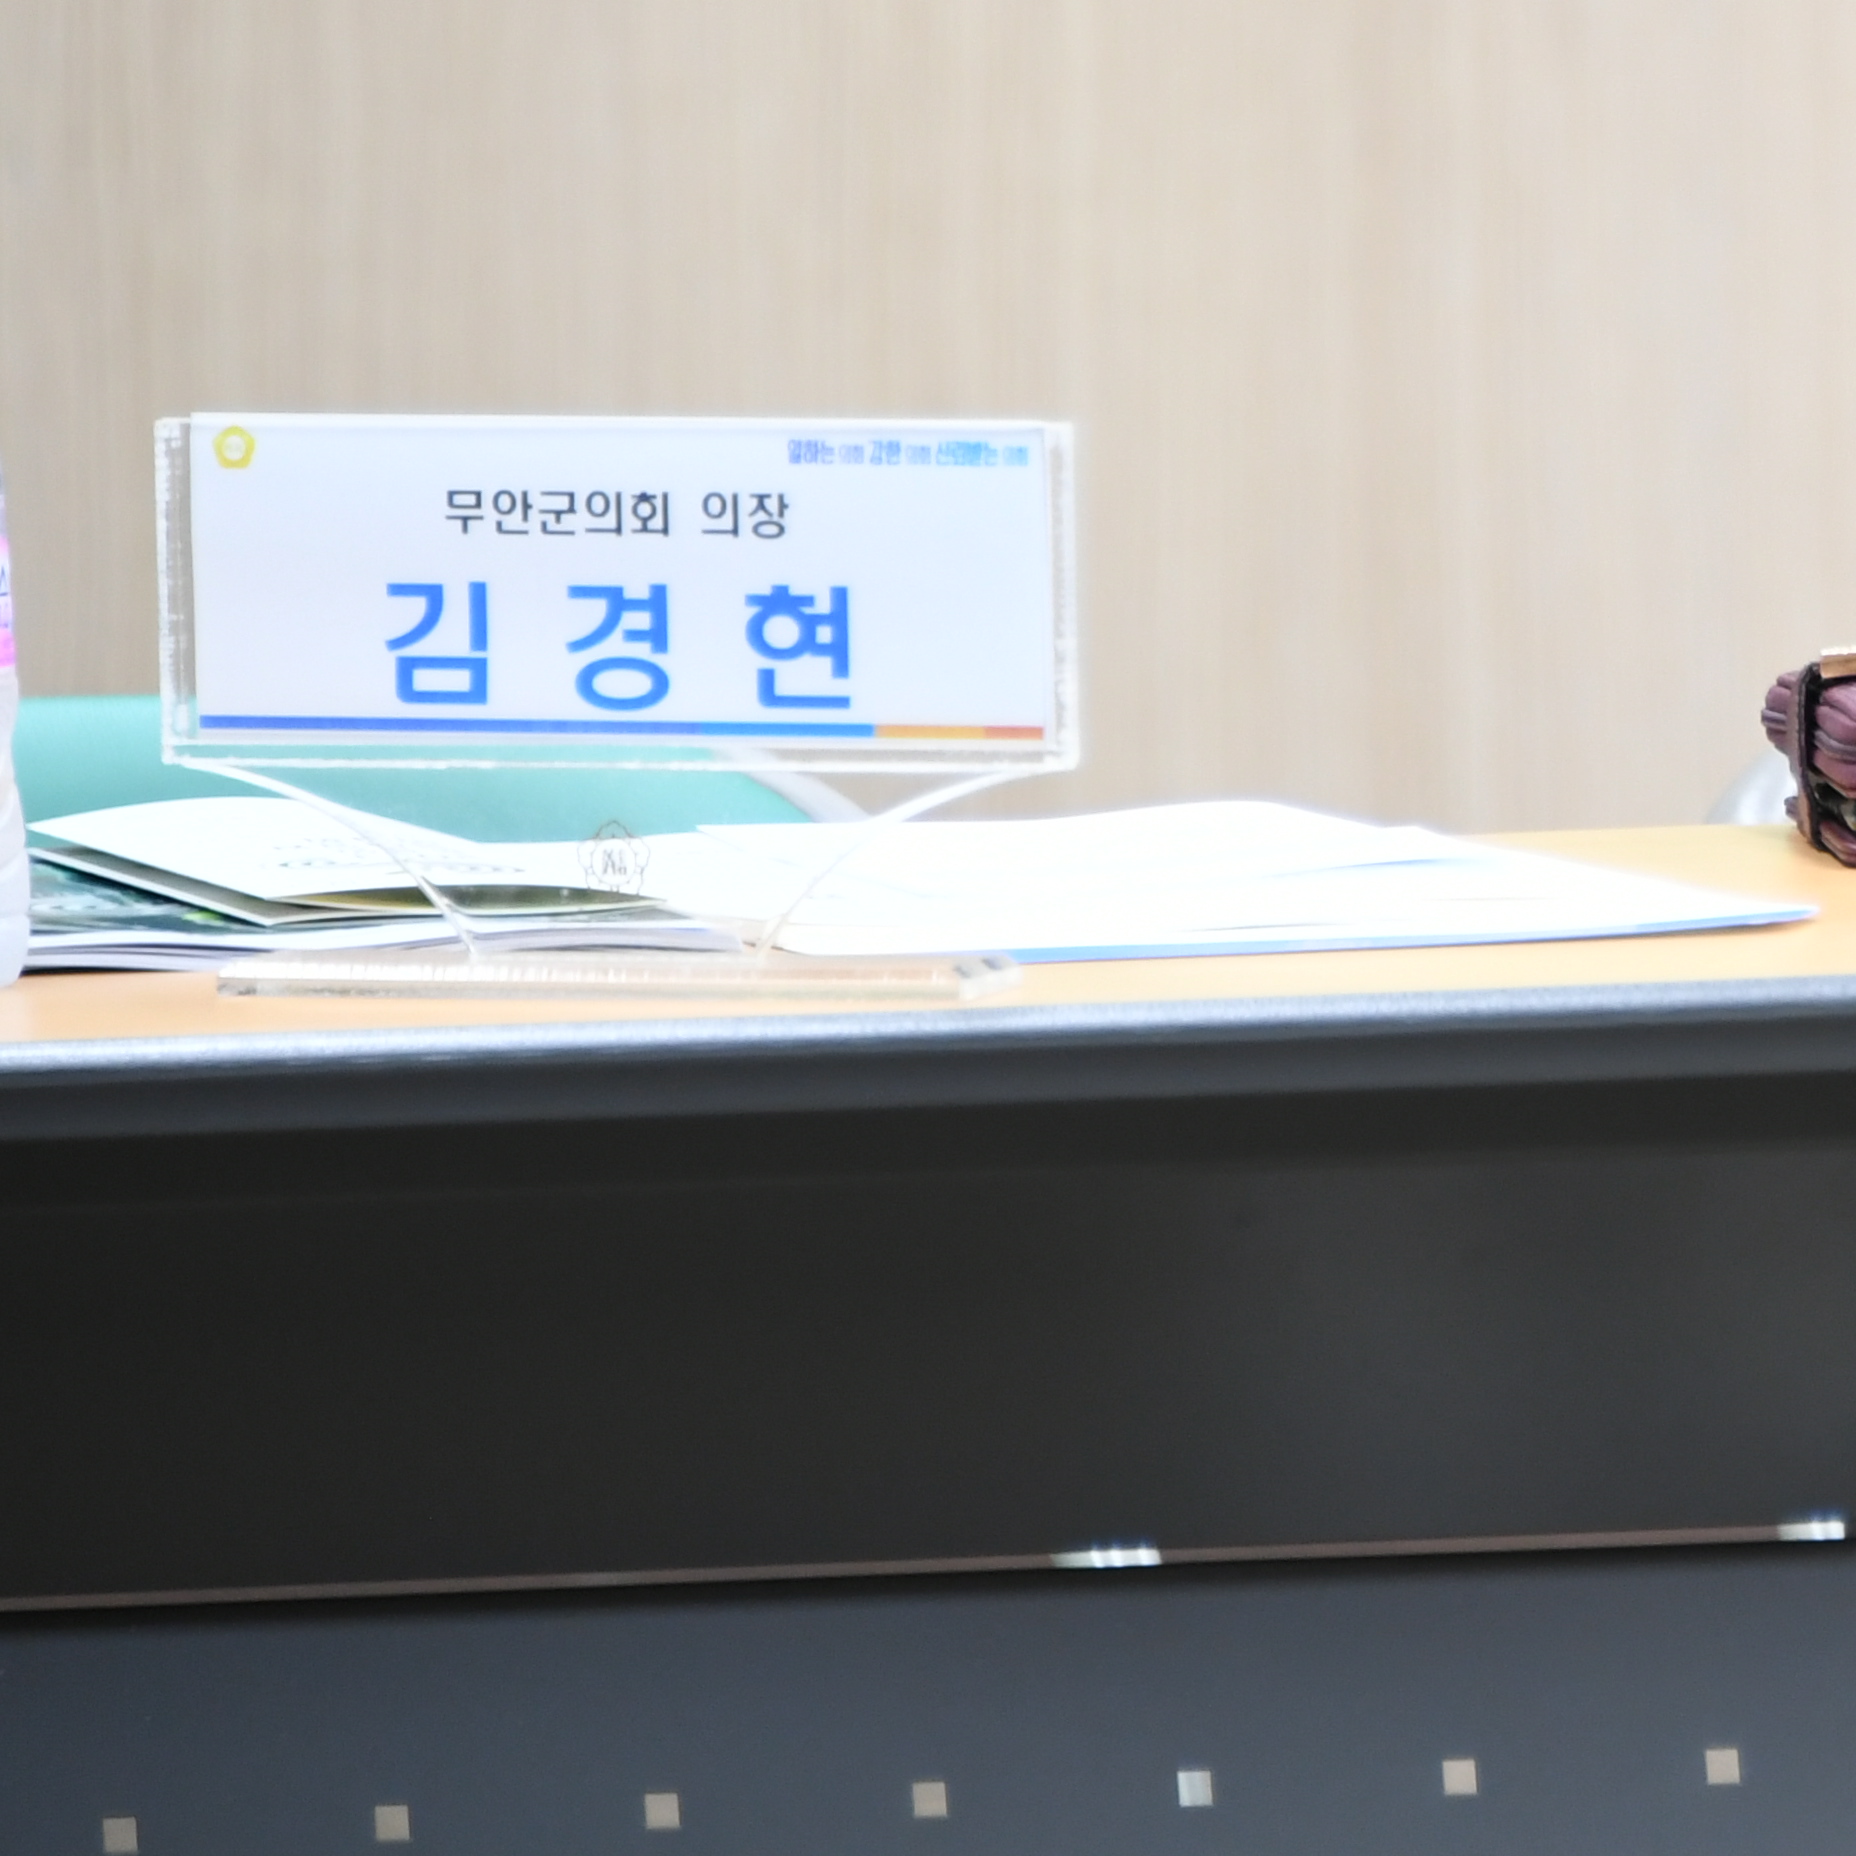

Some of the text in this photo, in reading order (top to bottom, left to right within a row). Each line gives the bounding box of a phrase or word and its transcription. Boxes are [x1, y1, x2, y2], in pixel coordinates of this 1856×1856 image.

[445, 489, 790, 540] 무안군의회 의장
[385, 581, 852, 712] 김 경 현
